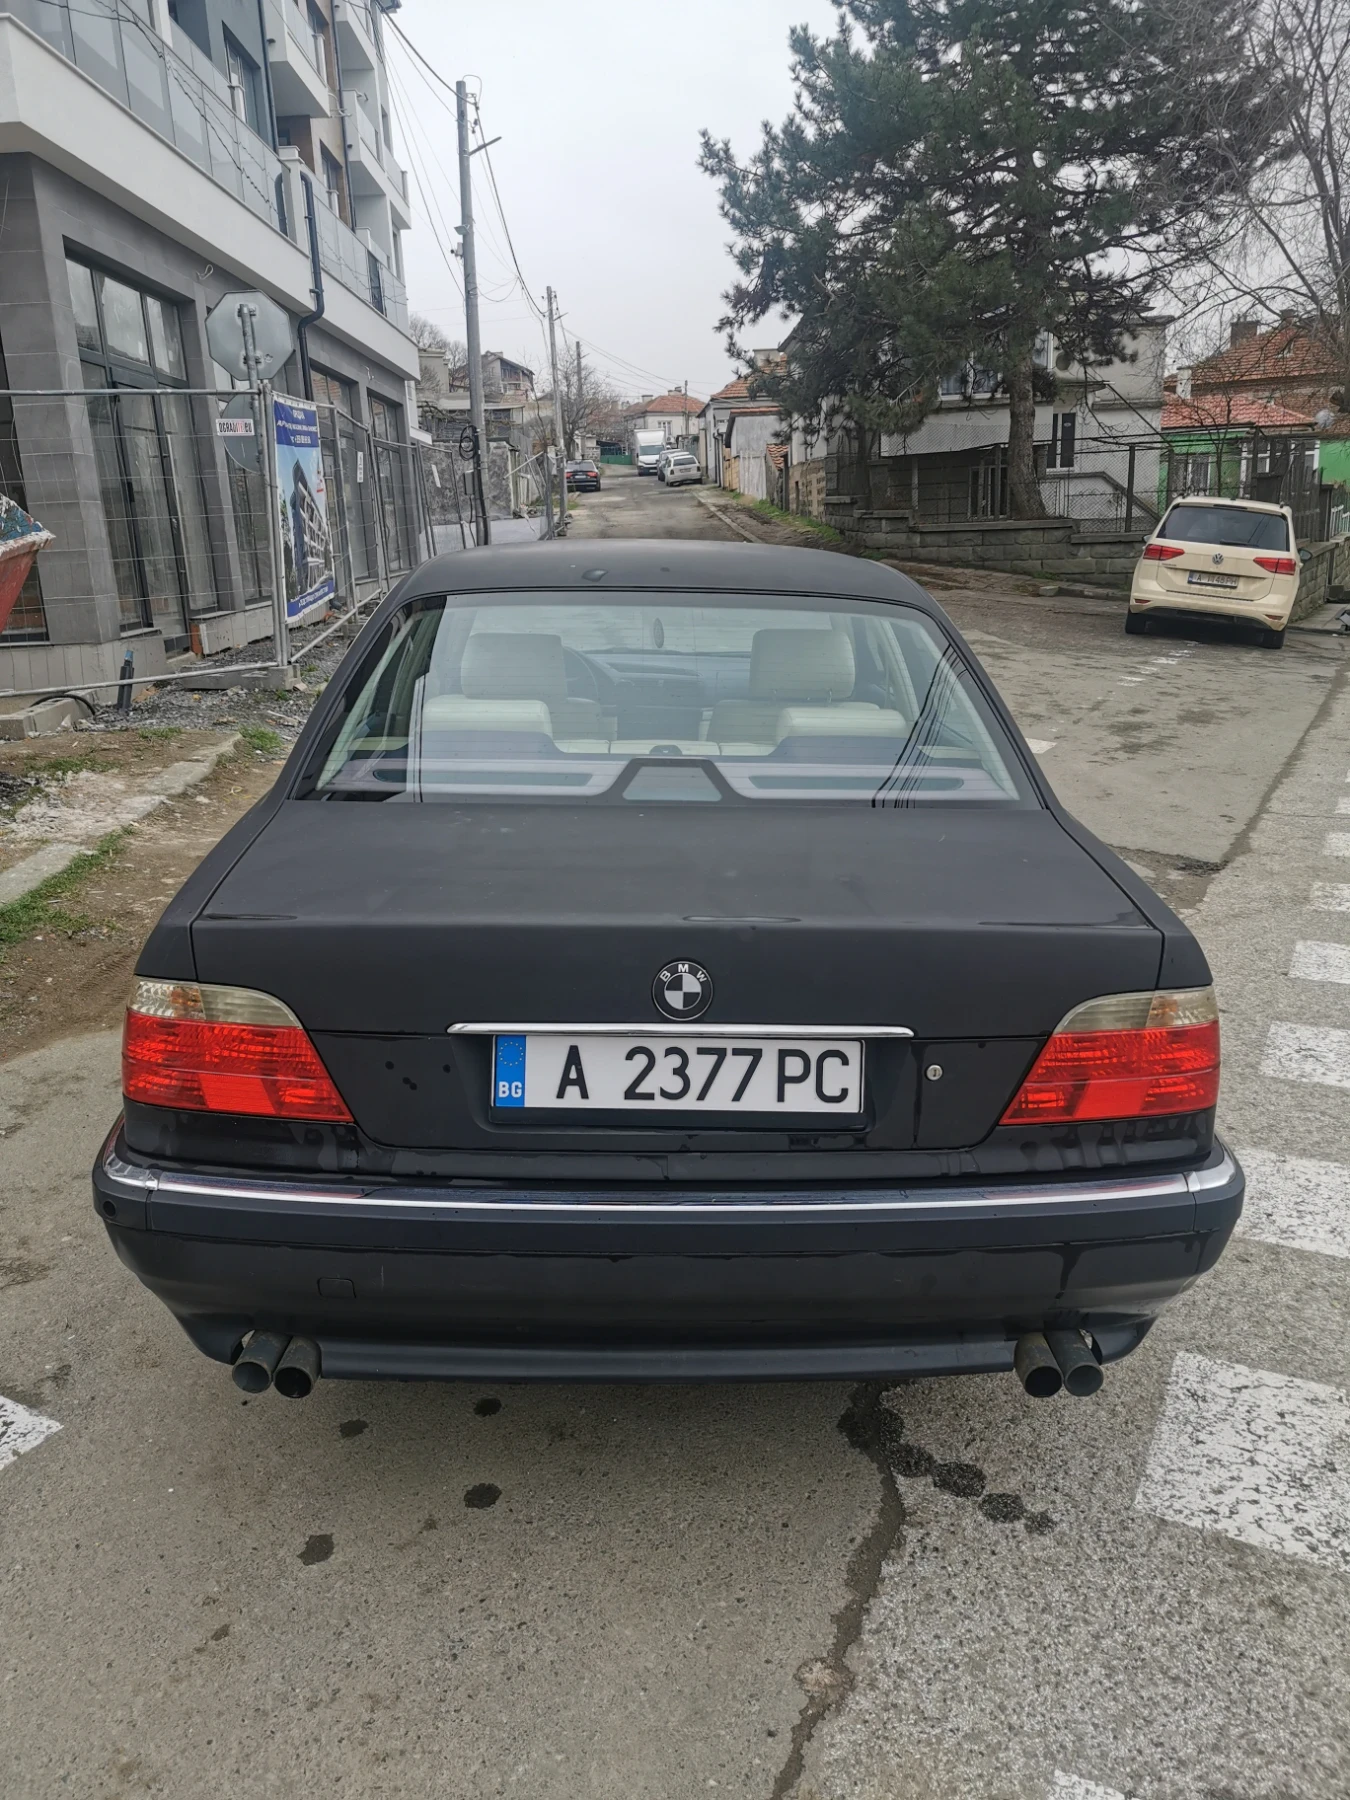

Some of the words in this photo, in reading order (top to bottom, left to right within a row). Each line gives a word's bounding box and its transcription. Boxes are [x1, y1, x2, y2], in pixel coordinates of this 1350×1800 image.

[660, 963, 707, 982] BMW
[556, 1045, 589, 1100] A
[498, 1081, 523, 1098] BG
